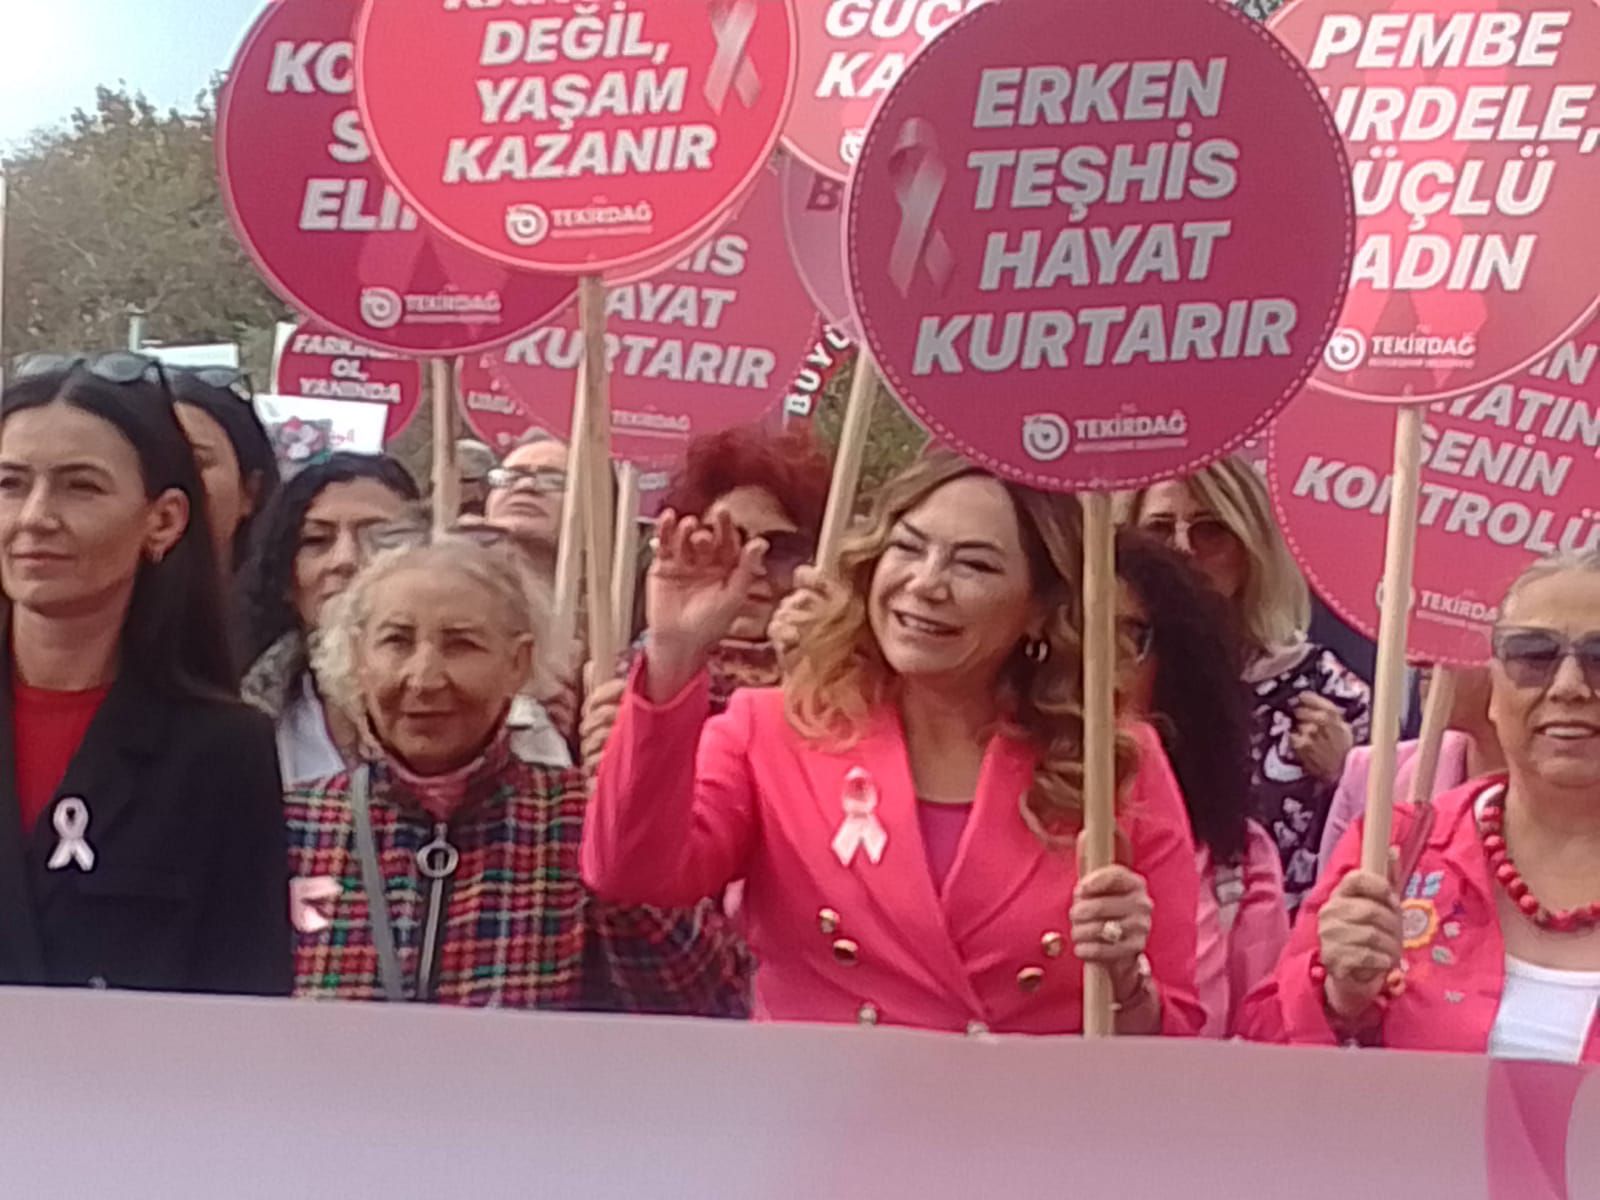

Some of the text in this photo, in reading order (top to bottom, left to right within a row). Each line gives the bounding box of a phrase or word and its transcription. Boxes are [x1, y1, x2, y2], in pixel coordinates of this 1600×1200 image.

[479, 0, 670, 65] DEĞİL,
[1307, 11, 1571, 69] PEMBE
[475, 66, 688, 131] YAŞAM
[815, 51, 906, 98] KA
[973, 58, 1227, 127] ERKEN
[442, 123, 717, 184] KAZANIR
[967, 122, 1239, 222] TEŞHİS
[1351, 145, 1556, 231] ÜÇLÜ
[979, 221, 1231, 290] HAYAT
[1349, 233, 1537, 291] ADIN
[607, 282, 737, 328] AYAT
[913, 299, 1297, 376] KURTARIR
[1371, 333, 1476, 356] TEKİRDAĞ
[1074, 409, 1187, 439] TEKİRDAĞ
